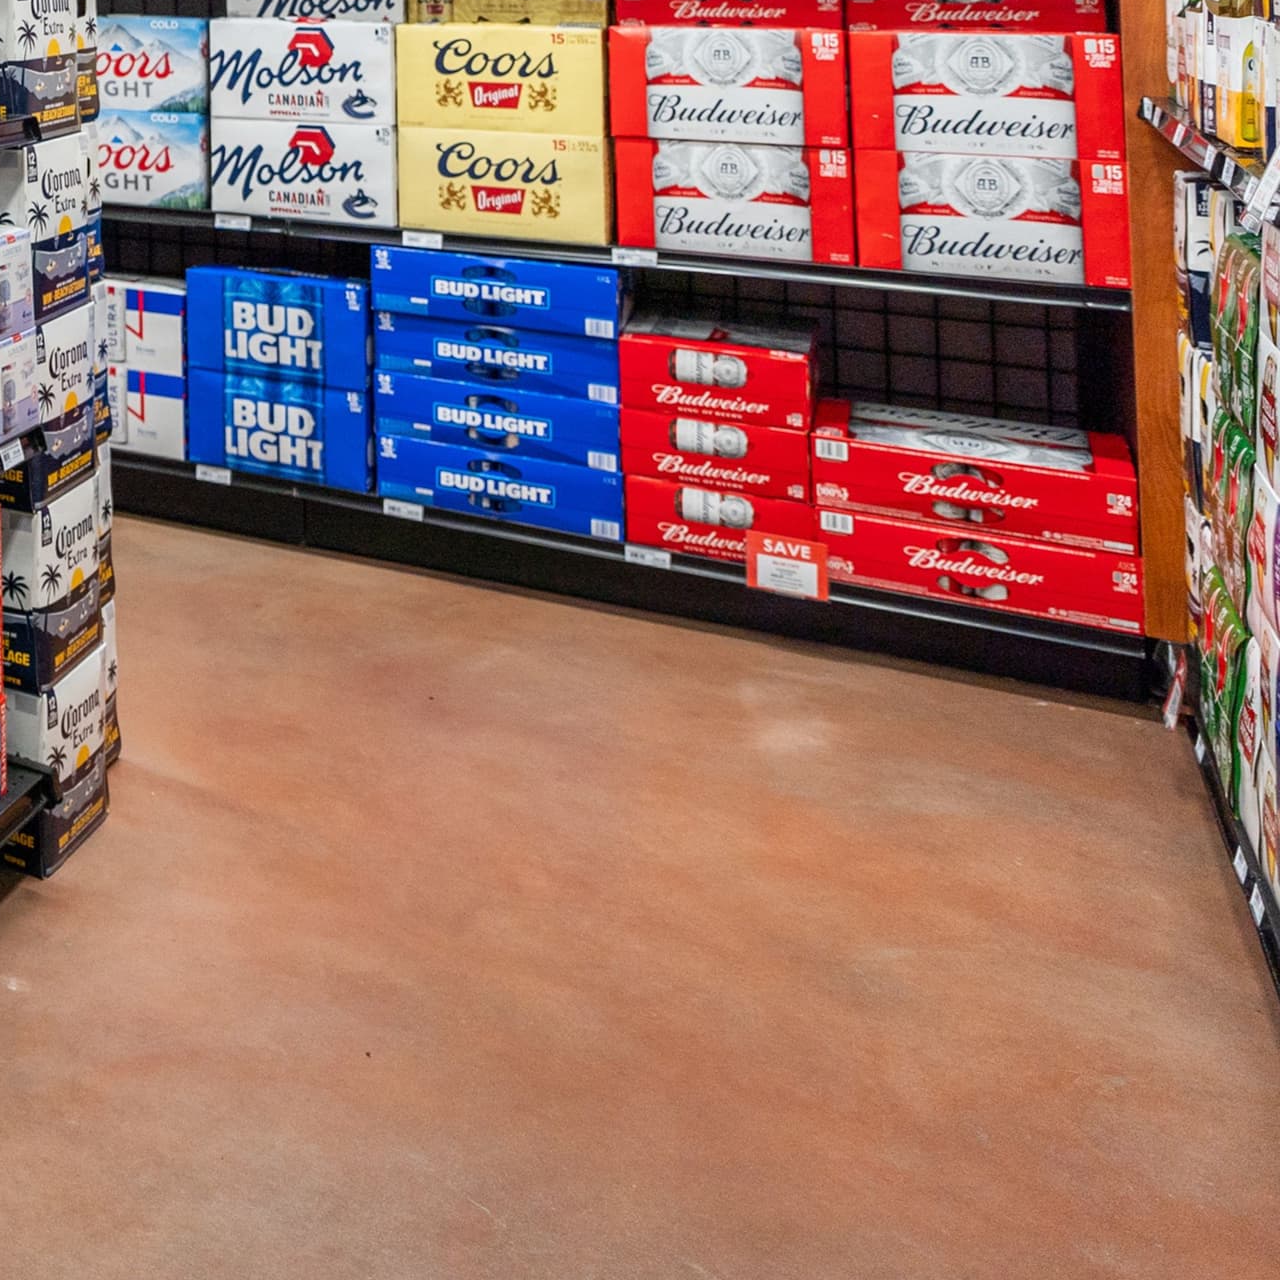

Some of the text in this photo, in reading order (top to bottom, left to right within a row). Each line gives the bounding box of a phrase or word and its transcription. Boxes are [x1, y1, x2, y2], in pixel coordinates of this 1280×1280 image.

[43, 15, 66, 36] Extra
[210, 46, 364, 103] Molson
[433, 37, 559, 80] Coors
[268, 90, 325, 109] CANADIAN
[474, 84, 519, 108] Original
[648, 94, 802, 128] Budweiser
[896, 104, 1076, 141] Budweiser
[232, 301, 314, 338] BUD
[225, 331, 322, 370] LIGHT
[440, 472, 552, 502] BUD LIGHT
[898, 471, 1039, 510] Budweiser
[763, 538, 812, 560] SAVE
